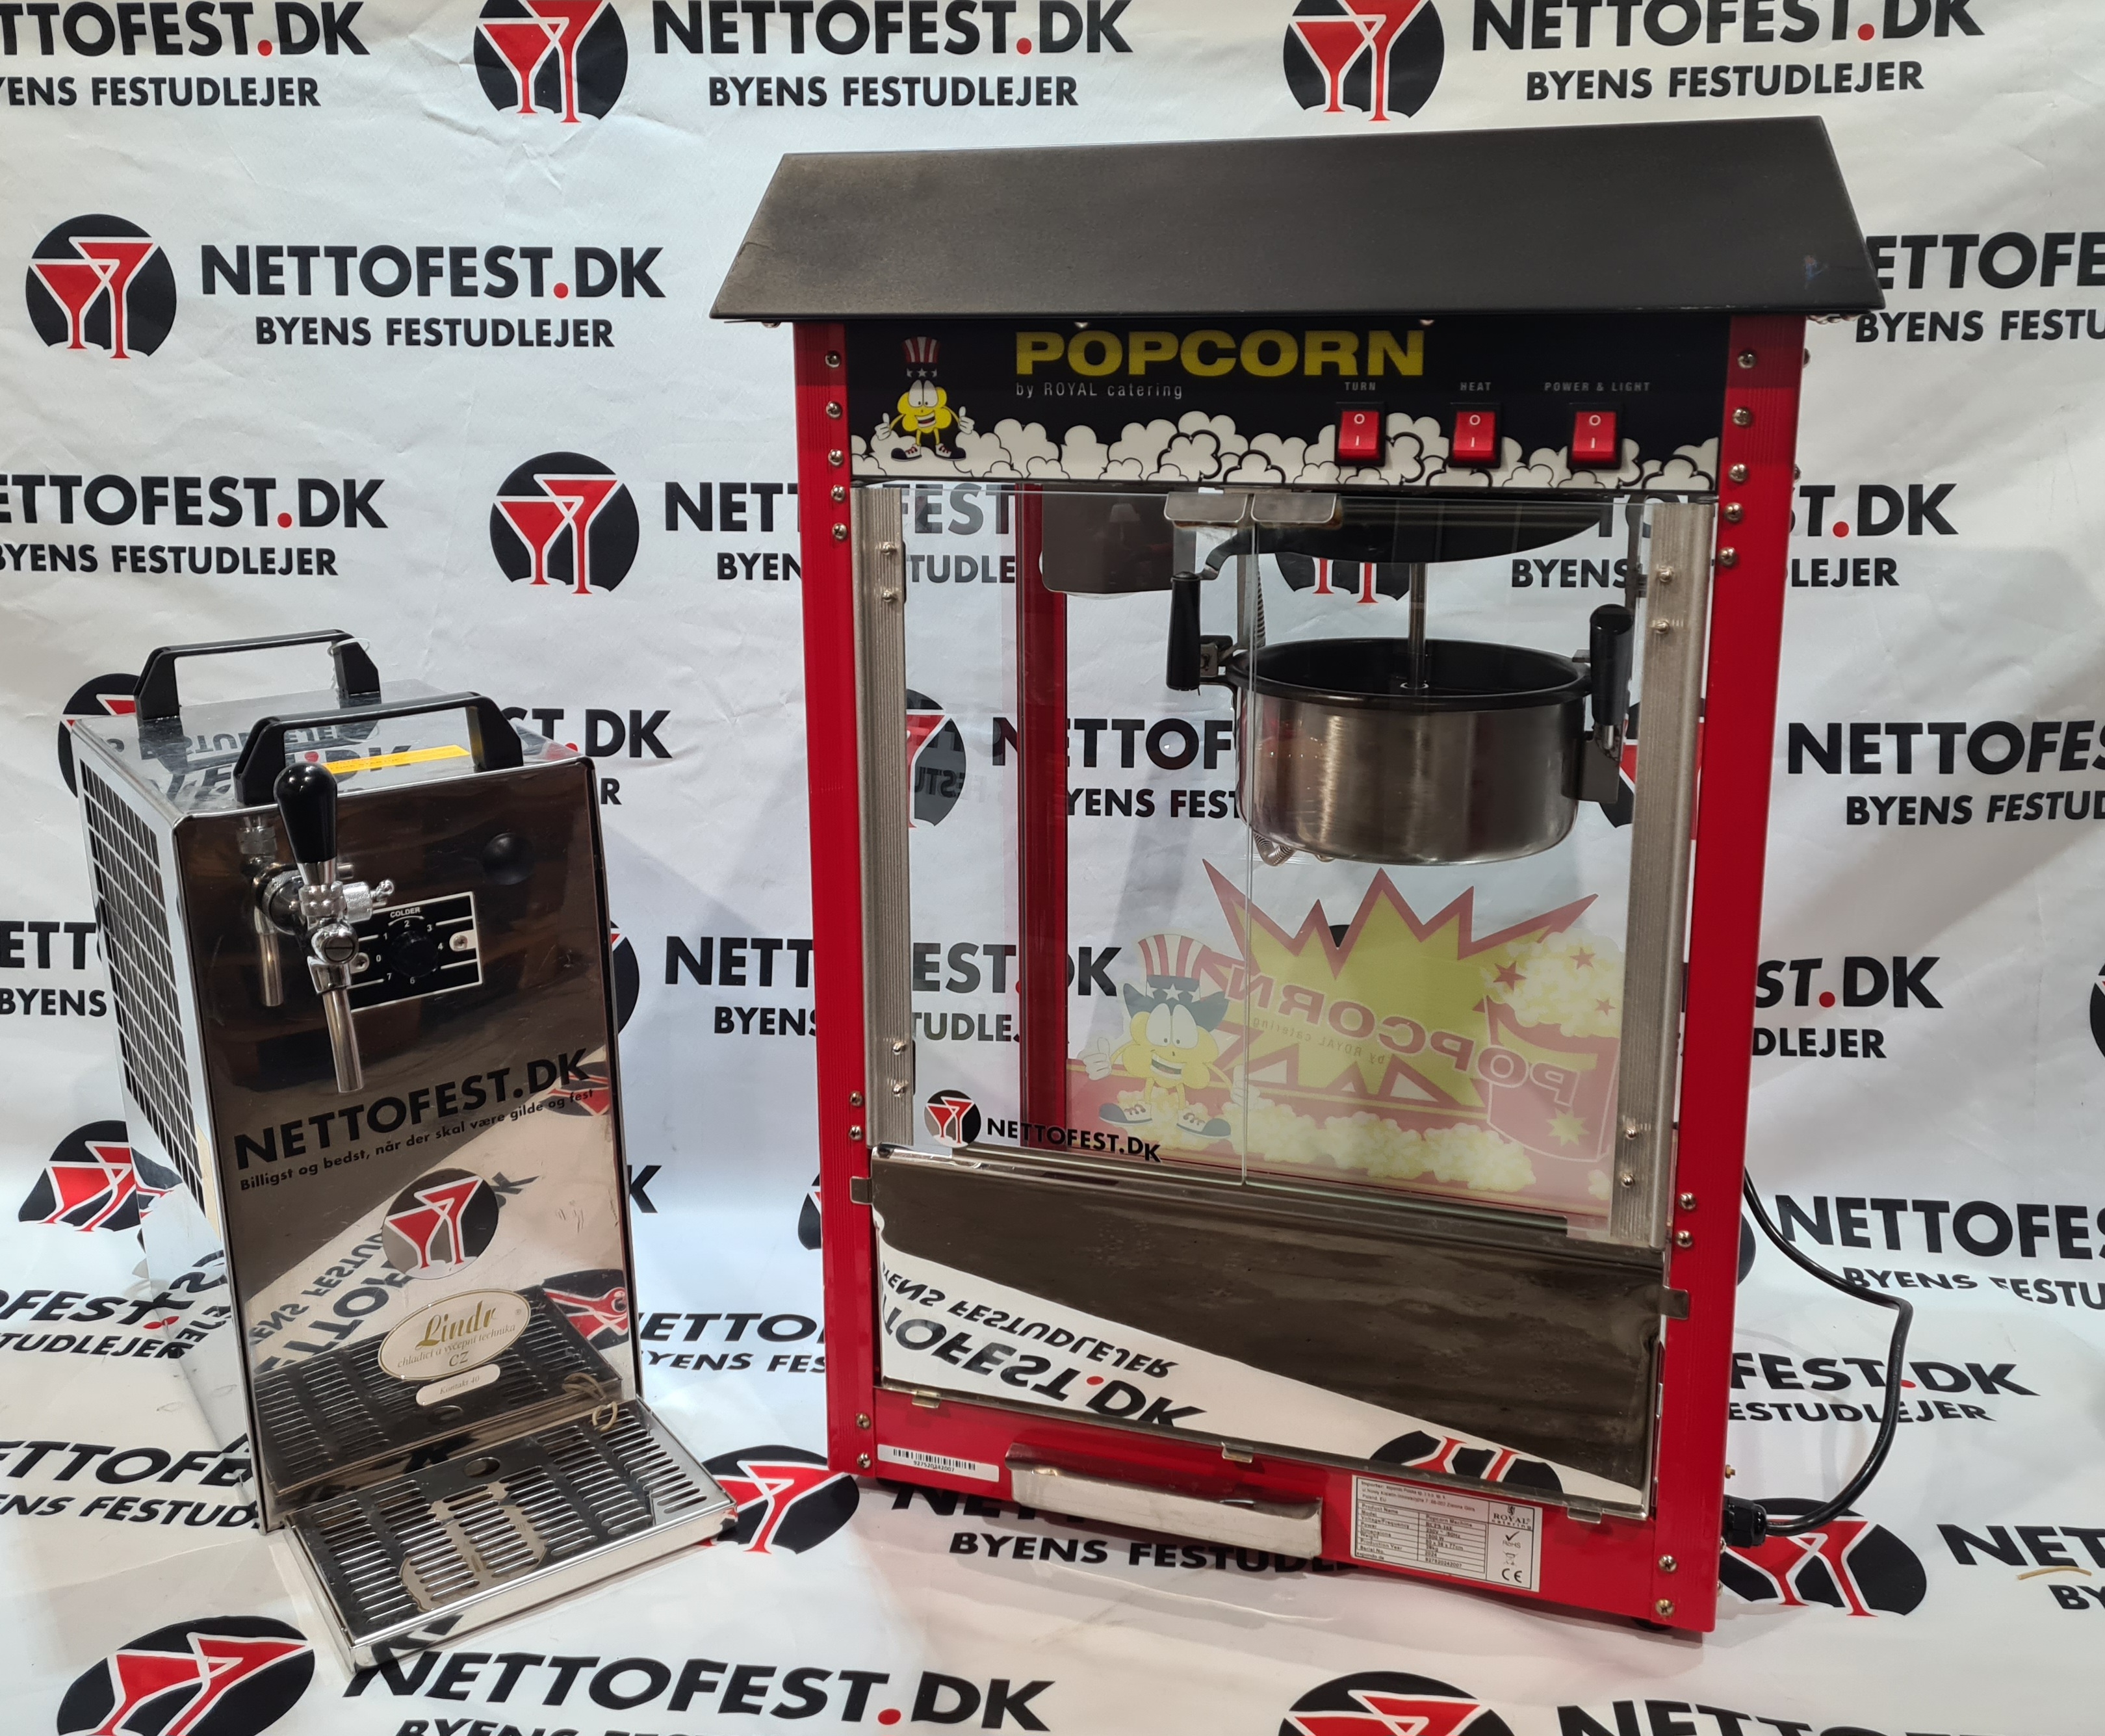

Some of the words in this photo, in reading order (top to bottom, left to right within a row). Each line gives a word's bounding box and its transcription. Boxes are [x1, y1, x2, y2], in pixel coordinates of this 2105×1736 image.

[653, 0, 1132, 55] NETTOFEST.DK
[92, 77, 320, 106] FESTUDLEJER
[710, 77, 827, 107] BYENS
[844, 77, 1077, 106] FESTUDLEJER
[1527, 68, 1651, 100] BYENS
[1670, 62, 1923, 97] FESTUDLEJER
[202, 246, 665, 298] NETTOFEST.DK
[257, 317, 370, 346] BYENS
[387, 318, 613, 347] FESTUDLEJER
[1856, 312, 1983, 343] BYENS
[1016, 330, 1425, 376] POPCORN
[1016, 383, 1035, 398] by
[1044, 383, 1098, 396] ROYAL
[1107, 382, 1183, 400] catering
[1345, 382, 1376, 391] TURN
[1460, 382, 1492, 391] HEAT
[1545, 382, 1590, 391] POWER
[1597, 382, 1605, 391] &
[1612, 382, 1650, 391] LIGHT
[0, 474, 387, 528] TTOFEST.DK
[1790, 484, 1959, 538] T.DK
[112, 545, 337, 575] FESTUDLEJER
[1512, 558, 1631, 588] BYENS
[1787, 558, 1900, 586] LEJER
[1847, 795, 1972, 825] BYENS
[390, 907, 421, 918] COLDER
[404, 920, 410, 928] 2
[437, 942, 444, 951] 4
[234, 1048, 590, 1170] NETTOFEST.DK
[240, 1169, 293, 1191] Billigst
[298, 1164, 318, 1175] og
[323, 1150, 370, 1169] bedst,
[376, 1141, 401, 1156] når
[406, 1132, 430, 1147] der
[435, 1121, 465, 1139] skal
[470, 1114, 505, 1129] være
[510, 1102, 543, 1121] gilde
[549, 1098, 565, 1110] og
[569, 1089, 593, 1103] fest
[987, 1118, 1162, 1163] NETTOFEST.DK
[1776, 1195, 2105, 1260] NETTOFE
[1843, 1267, 1978, 1289] BYENS
[415, 1301, 498, 1351] Lindr
[636, 1312, 825, 1344] ETTO
[449, 1351, 469, 1367] CZ
[640, 1350, 754, 1371] YENS
[1492, 1519, 1531, 1531] catering
[1493, 1512, 1529, 1525] ROYAL
[949, 1533, 1109, 1562] BYENS
[344, 1651, 1055, 1731] NETTOFEST.DK
